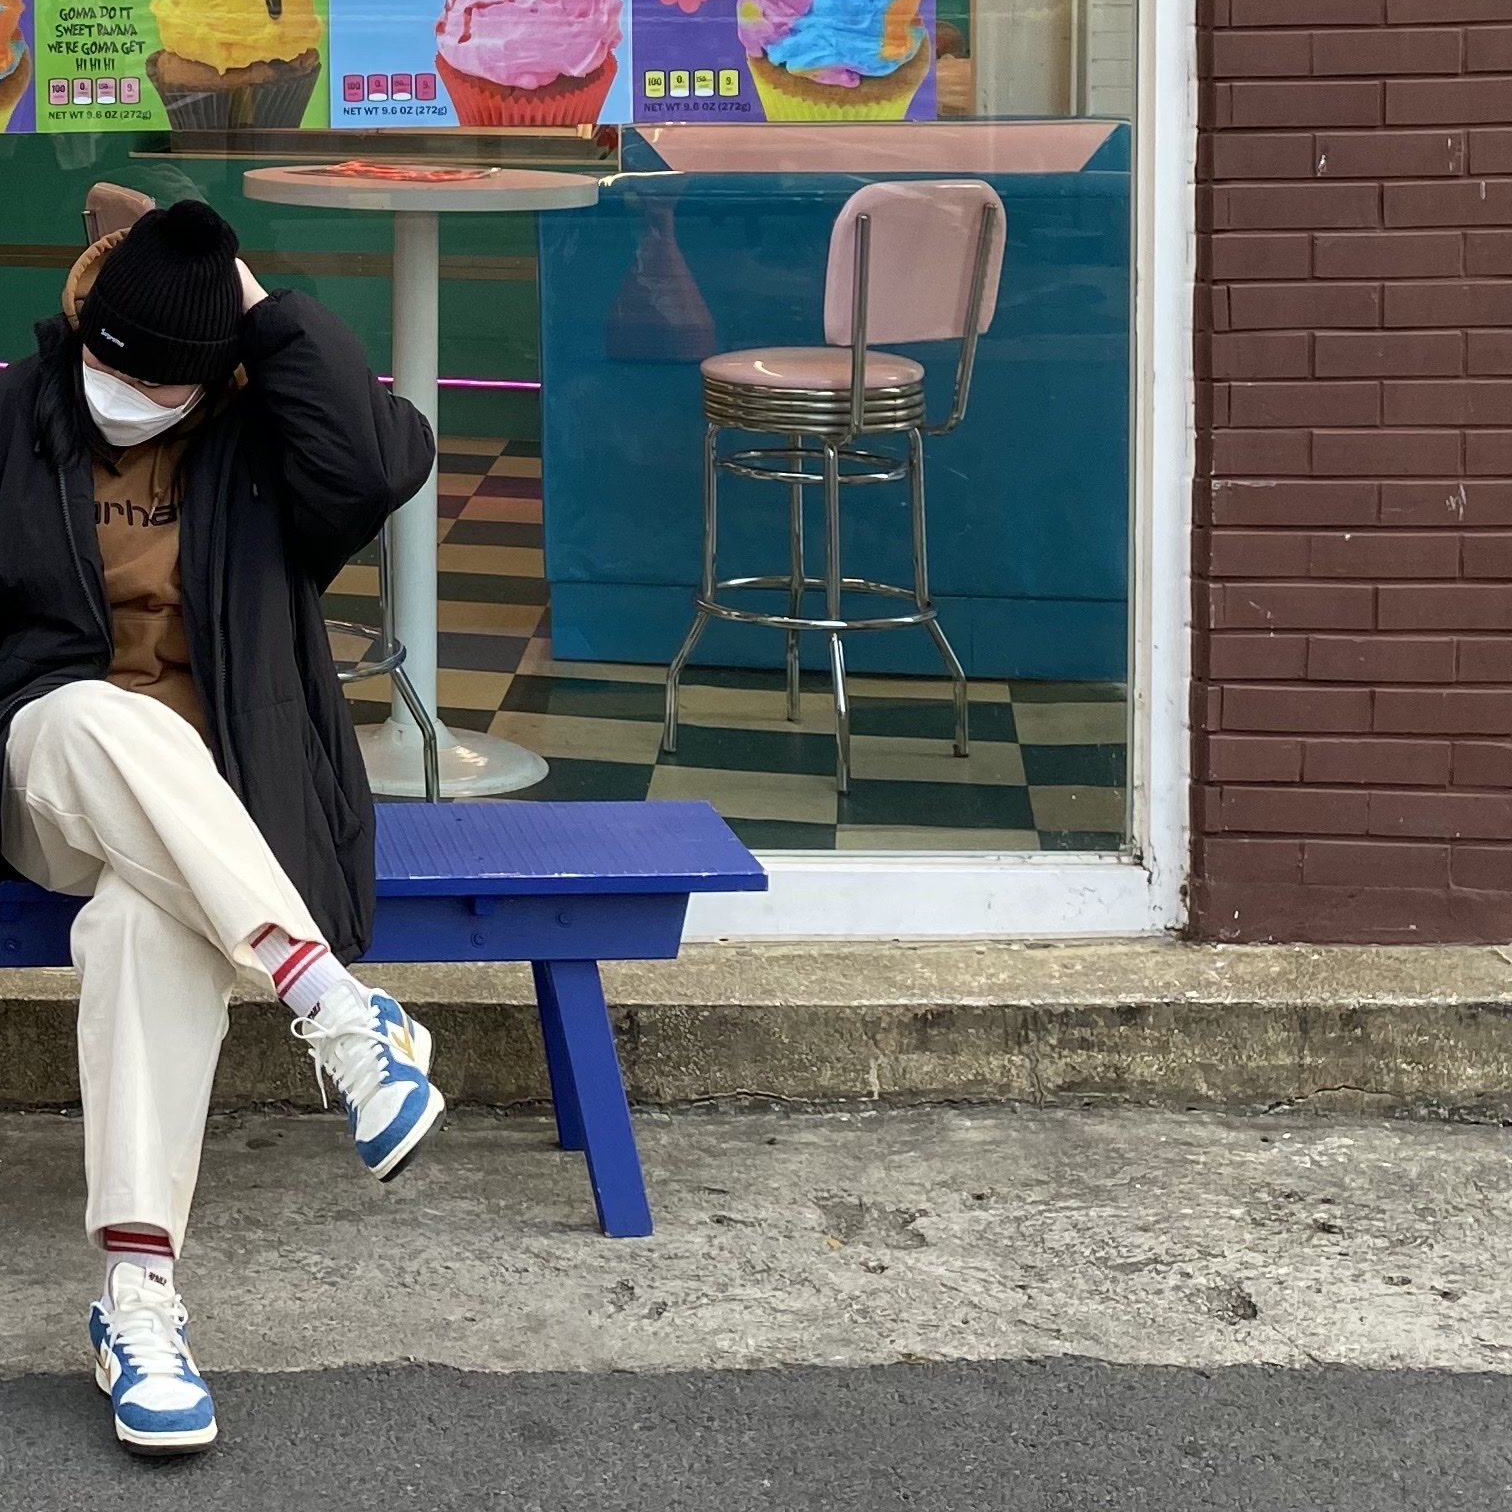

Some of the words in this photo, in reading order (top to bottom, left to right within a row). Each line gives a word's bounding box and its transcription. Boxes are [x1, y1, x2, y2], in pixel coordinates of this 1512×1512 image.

[59, 7, 97, 21] GONNA
[99, 6, 116, 19] DO
[119, 6, 133, 20] IT
[55, 23, 95, 38] SWEET
[96, 23, 138, 37] BANANA
[81, 41, 119, 55] GONNA
[121, 40, 146, 54] GET
[343, 107, 362, 115] NET
[364, 107, 379, 115] WT
[400, 106, 413, 114] OZ
[644, 103, 663, 111] NET
[665, 103, 681, 111] WT
[48, 111, 67, 119] NET
[69, 111, 84, 119] WT
[105, 110, 118, 119] OZ
